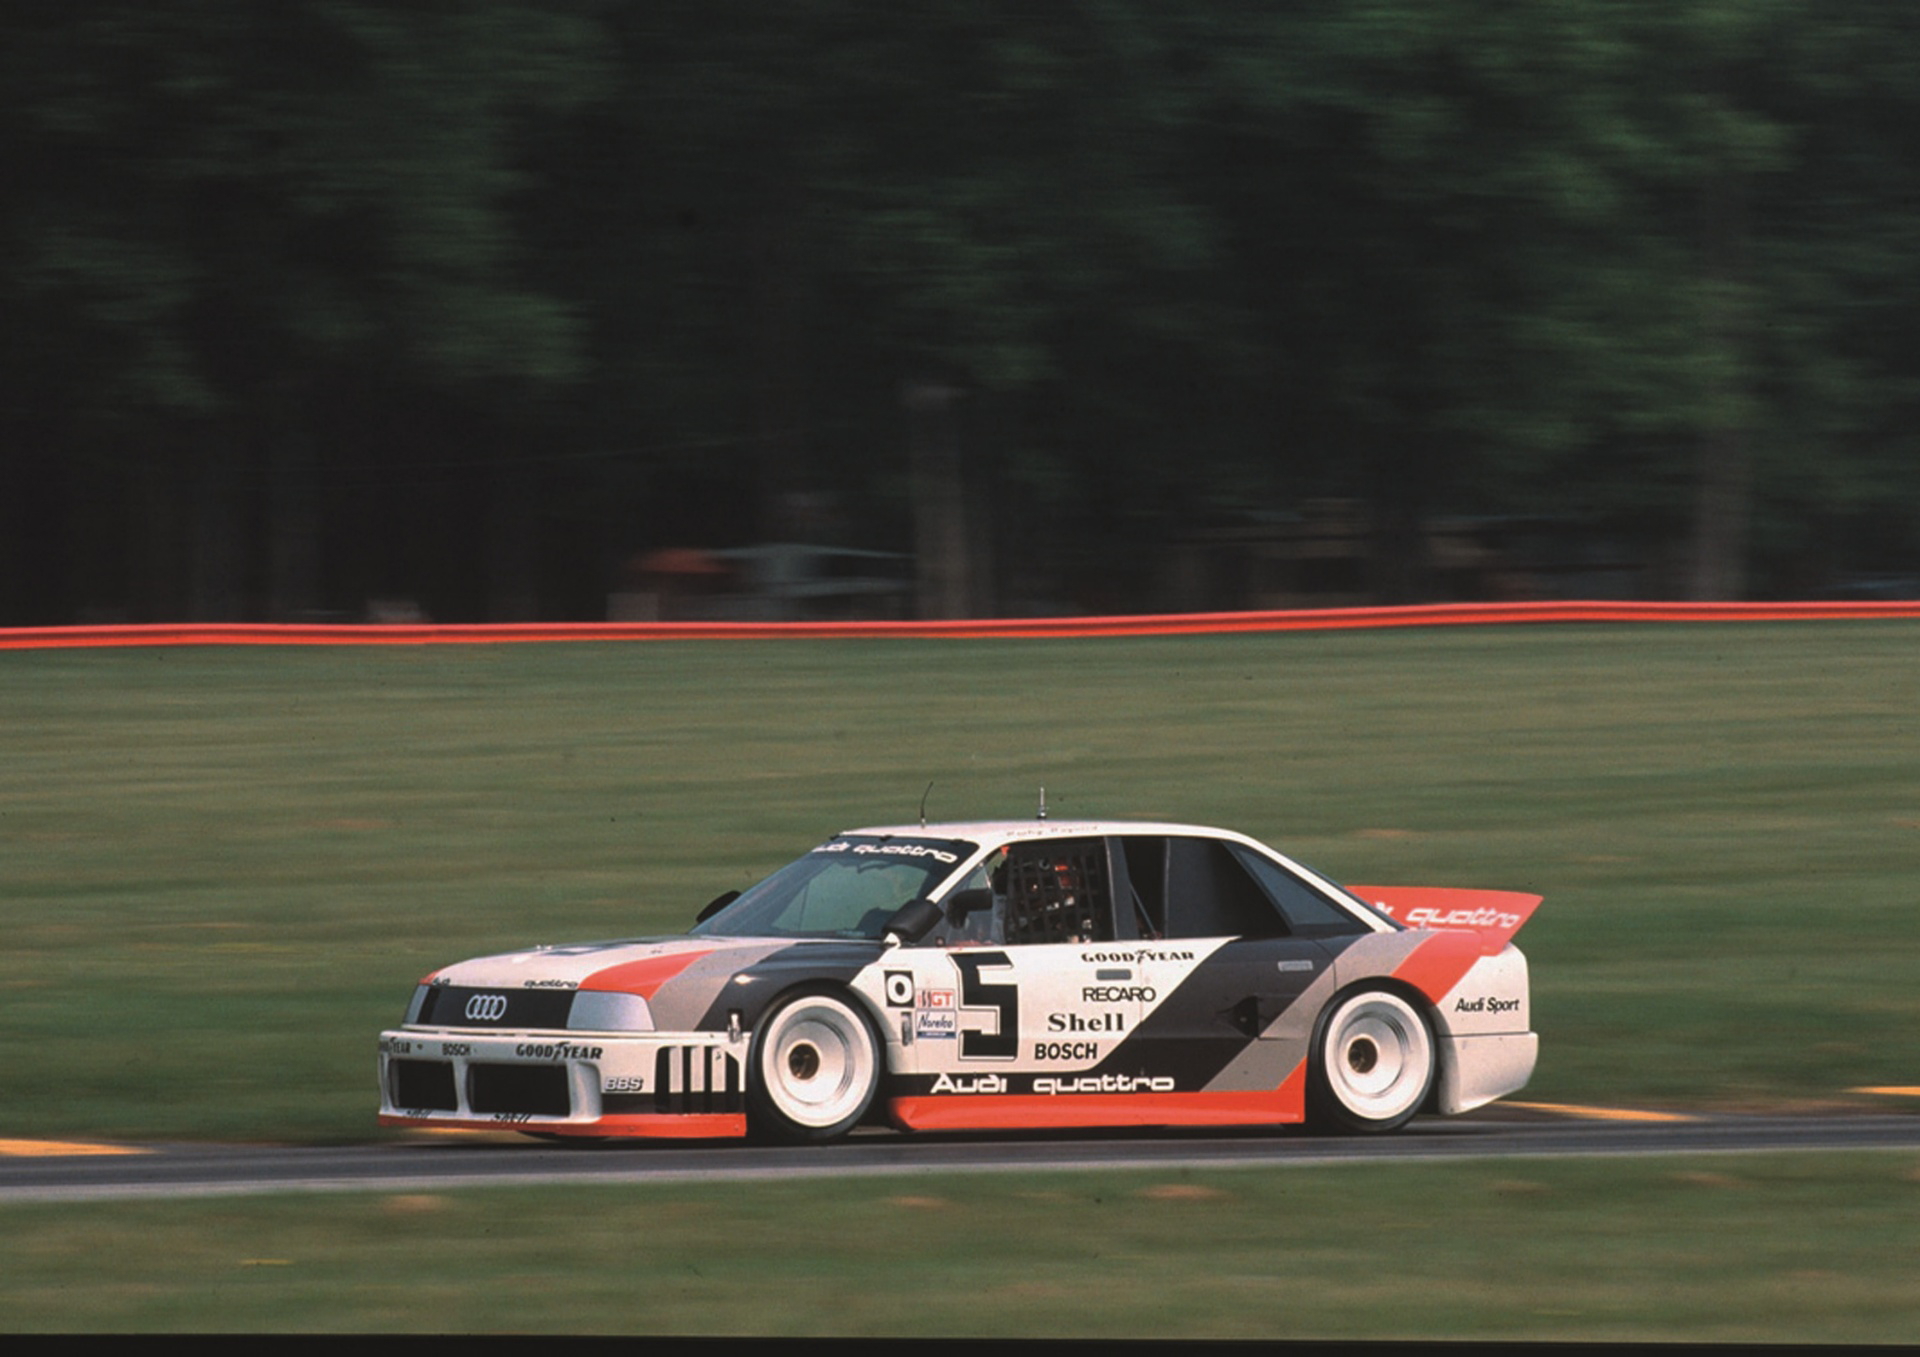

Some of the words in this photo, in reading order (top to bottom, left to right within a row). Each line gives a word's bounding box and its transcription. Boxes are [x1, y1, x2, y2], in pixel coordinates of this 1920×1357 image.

[853, 845, 958, 863] quattro
[1405, 908, 1521, 929] quattro
[1081, 950, 1195, 964] GOODYEAR
[524, 979, 579, 989] quattro
[932, 991, 954, 1006] GT
[1083, 987, 1156, 1002] RECARO
[949, 951, 1019, 1062] 5
[1455, 997, 1484, 1012] Audi
[1486, 997, 1520, 1014] Sport
[1048, 1013, 1124, 1031] Shell
[442, 1043, 471, 1056] BOSCH
[516, 1042, 603, 1060] GOODYEAR
[1035, 1043, 1098, 1060] BOSCH
[605, 1077, 644, 1092] BBS
[931, 1073, 1008, 1093] Audi
[1033, 1074, 1175, 1095] quattro
